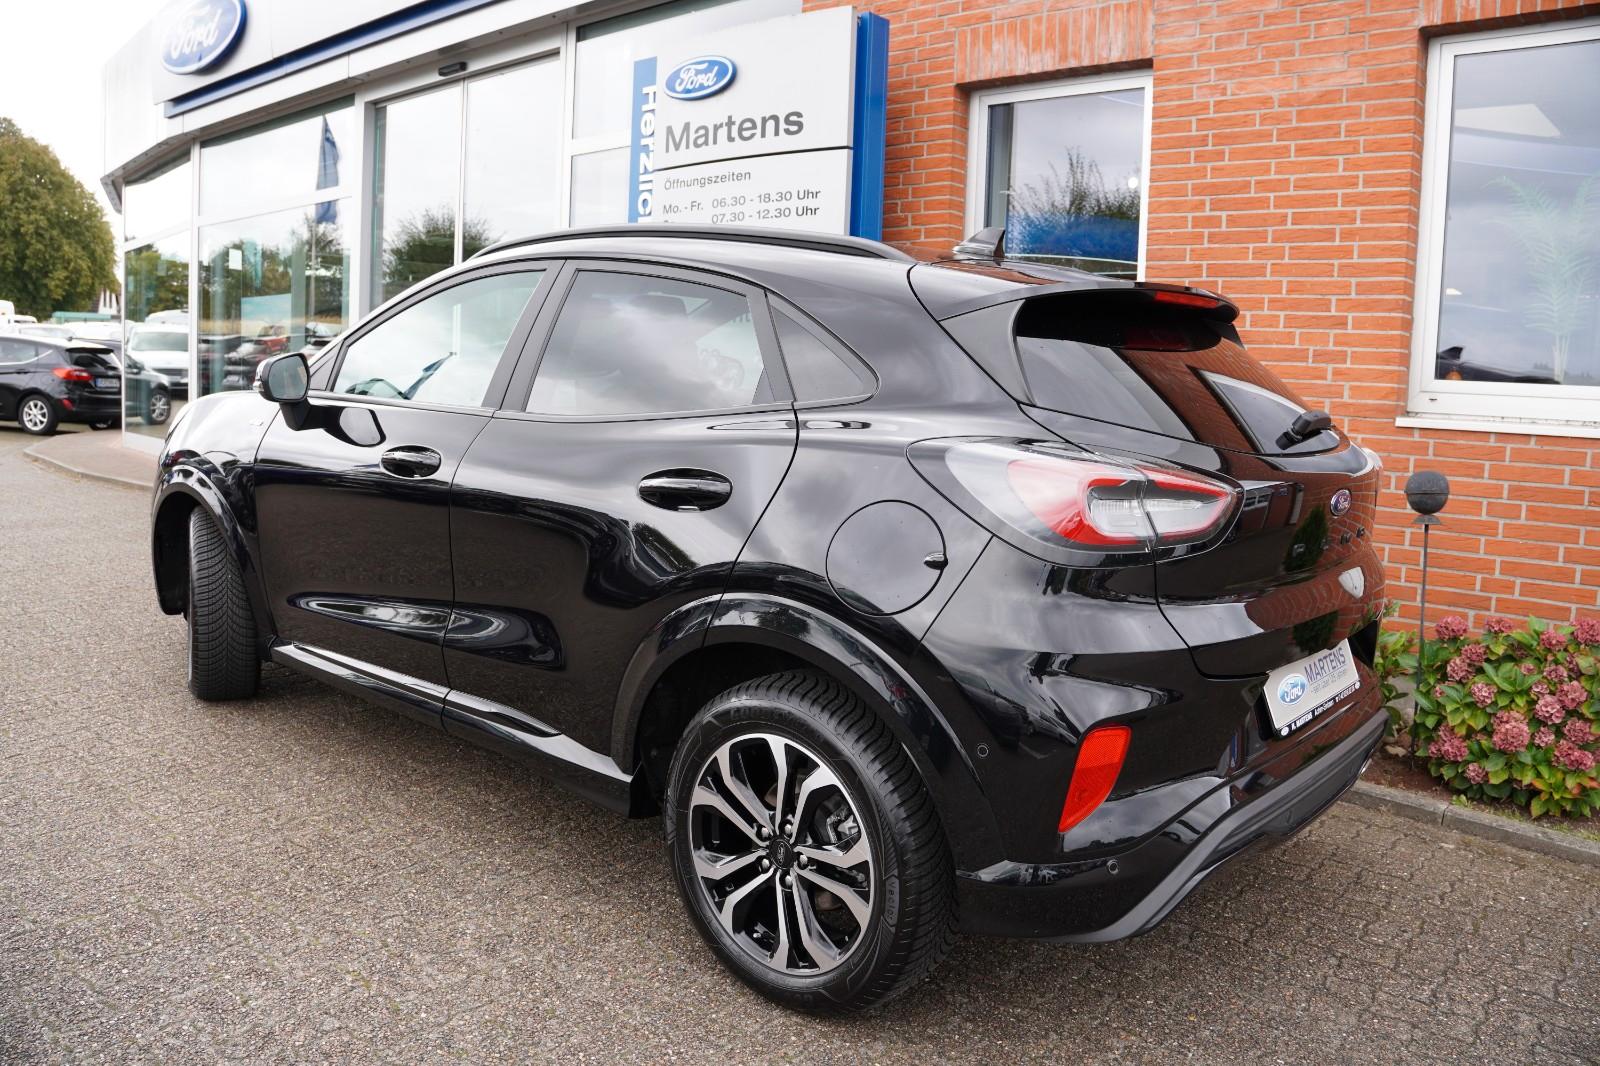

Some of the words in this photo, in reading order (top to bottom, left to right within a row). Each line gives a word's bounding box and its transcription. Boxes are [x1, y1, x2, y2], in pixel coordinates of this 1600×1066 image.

[169, 4, 222, 60] Ford
[675, 62, 719, 93] Ford
[665, 110, 804, 153] Martens
[664, 170, 751, 191] Öffnungszeiten
[663, 204, 682, 215] Mo.
[690, 200, 704, 211] Fr.
[712, 195, 746, 208] 06.30
[758, 190, 792, 204] 18.30
[797, 189, 821, 201] Uhr
[711, 212, 745, 225] 07.30
[757, 207, 791, 220] 12.30
[795, 206, 820, 217] Uhr
[1304, 647, 1346, 682] MARTENS
